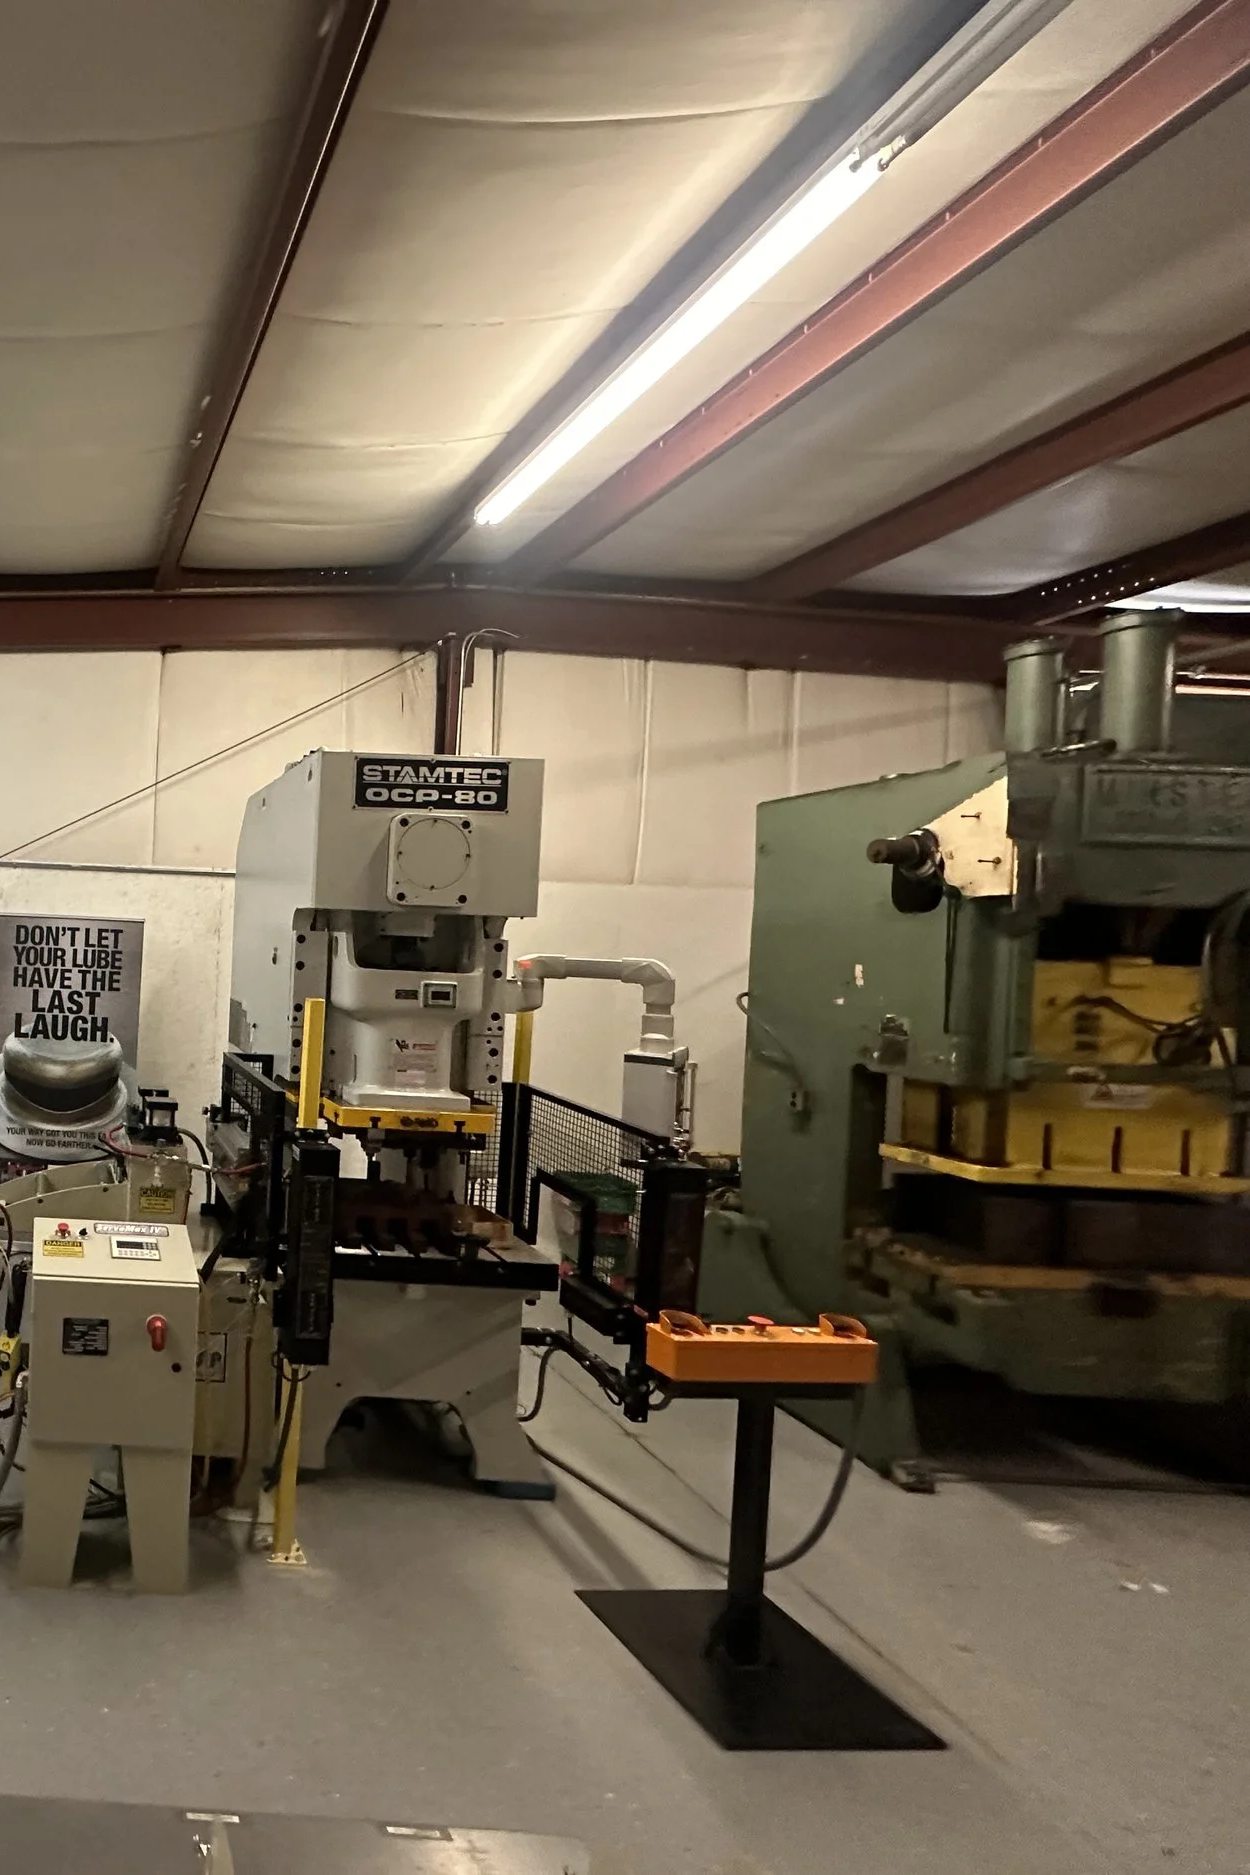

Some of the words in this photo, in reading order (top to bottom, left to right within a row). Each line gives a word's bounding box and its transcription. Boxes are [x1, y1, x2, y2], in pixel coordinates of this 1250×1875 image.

[362, 765, 502, 785] STAMTEC
[365, 787, 498, 805] OCP-80
[15, 925, 80, 947] DON'T
[84, 927, 123, 949] LET
[13, 946, 66, 967] YOUR
[72, 948, 123, 970] LUBE
[13, 966, 72, 989] HAVE
[77, 969, 121, 992] THE
[31, 989, 101, 1015] LAST
[14, 1013, 115, 1043] LAUGH.
[6, 1126, 26, 1135] YOUR
[62, 1130, 77, 1139] YOU
[78, 1131, 96, 1140] THIS
[26, 1138, 43, 1147] NOW
